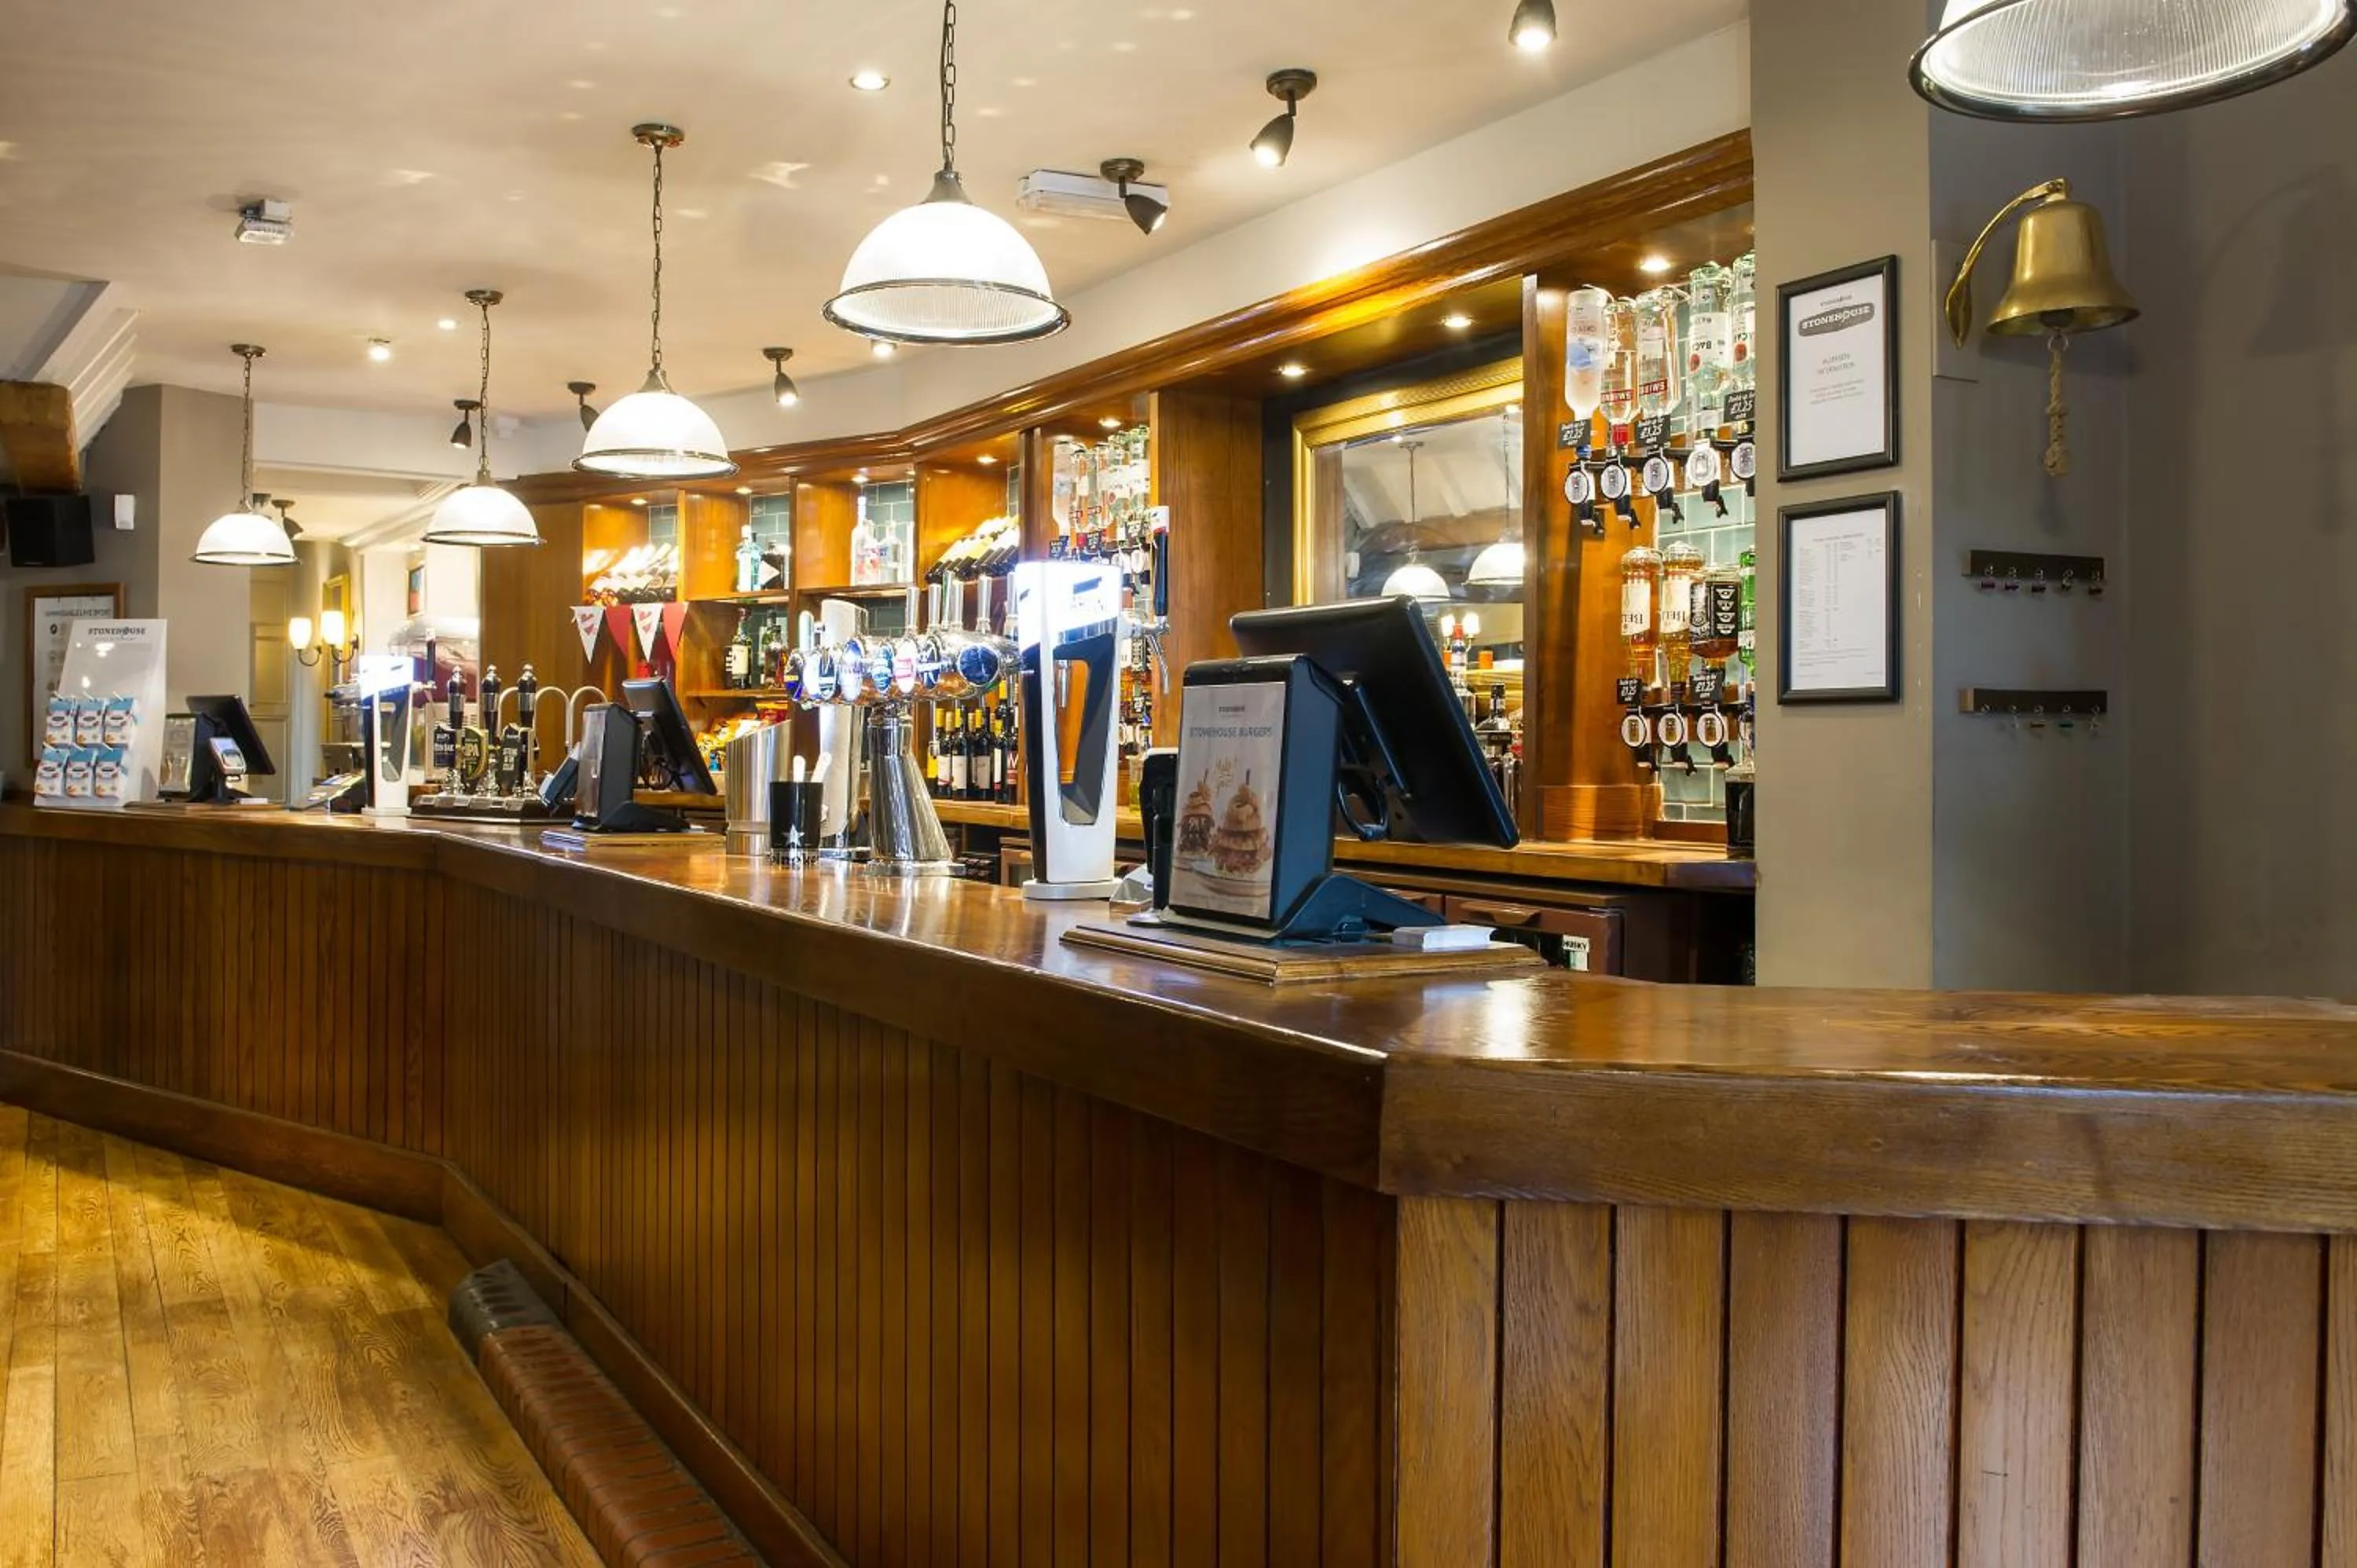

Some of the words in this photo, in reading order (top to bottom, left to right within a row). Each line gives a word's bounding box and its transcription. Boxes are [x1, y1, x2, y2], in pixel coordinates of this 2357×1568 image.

[1801, 306, 1871, 329] STONEHOUSE
[87, 626, 146, 636] STONEHOUSE
[1189, 727, 1237, 738] STONEHOUSE
[1239, 726, 1273, 738] BURGERS
